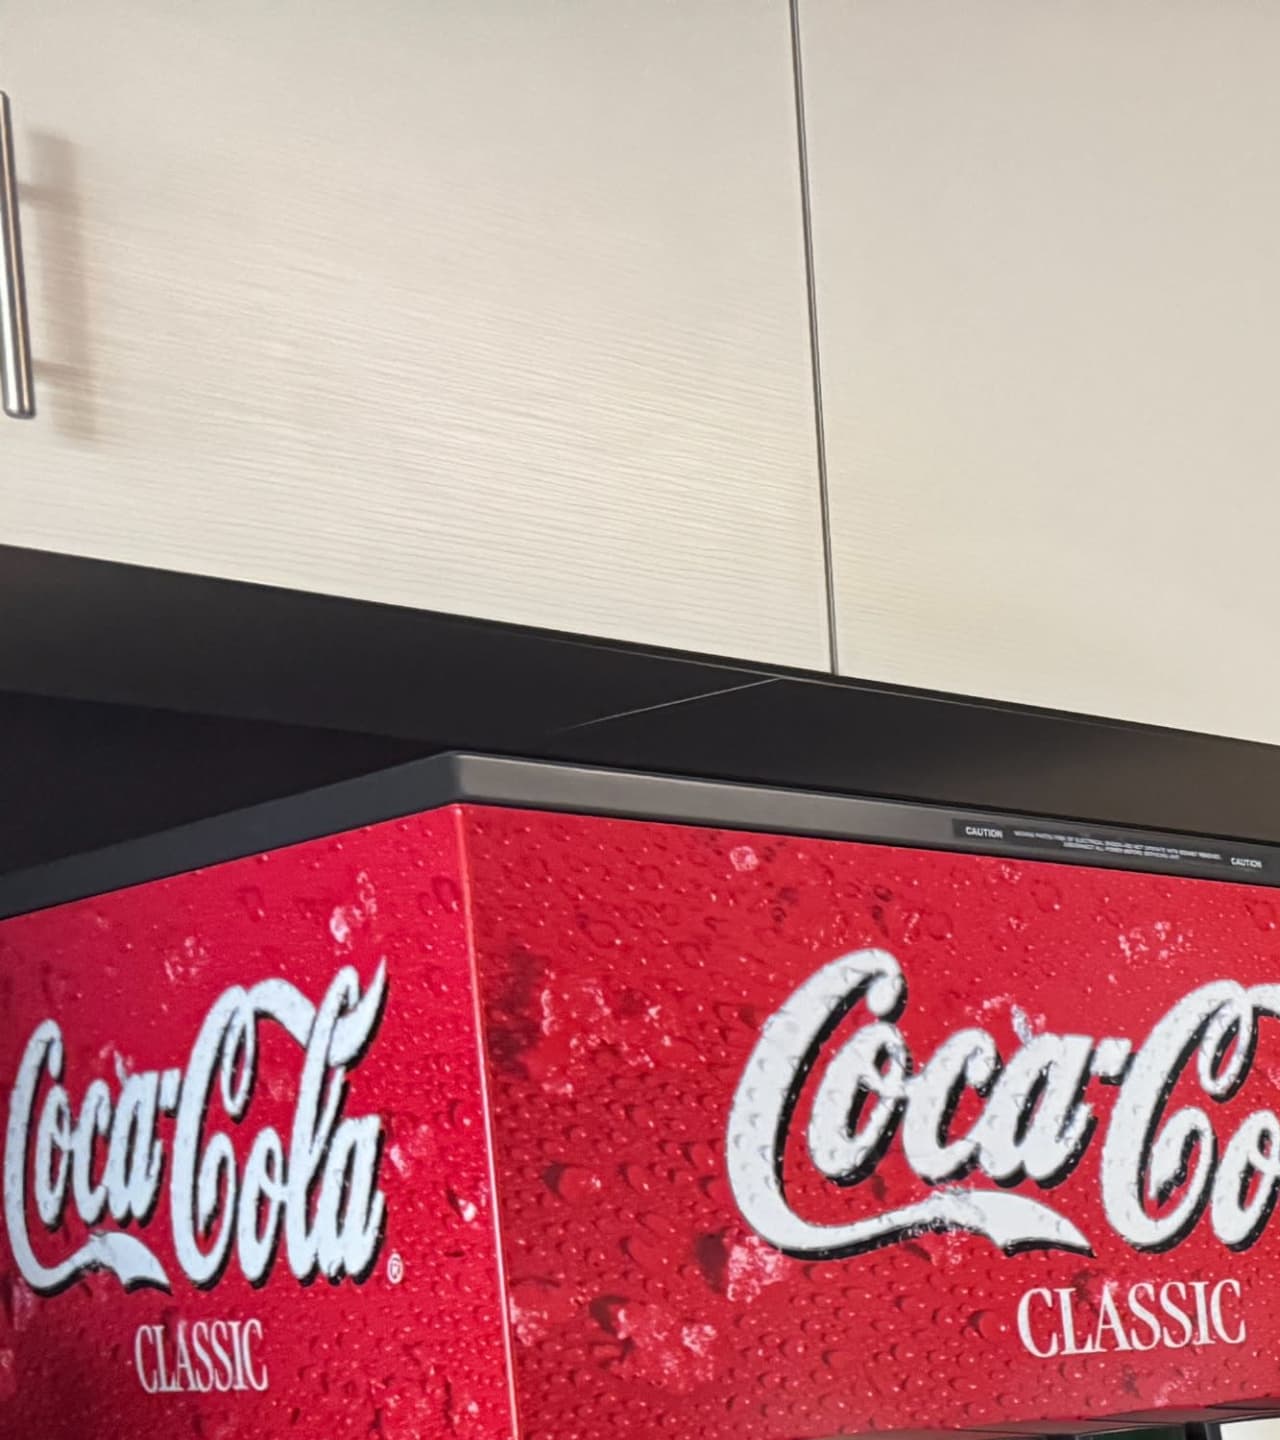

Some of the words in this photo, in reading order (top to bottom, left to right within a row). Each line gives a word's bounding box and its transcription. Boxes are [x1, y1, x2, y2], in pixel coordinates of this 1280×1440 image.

[965, 826, 1003, 839] CAUTION
[5, 955, 388, 1296] Coca-Cola
[134, 1319, 269, 1393] CLASSIC
[1016, 1278, 1247, 1358] CLASSIC
